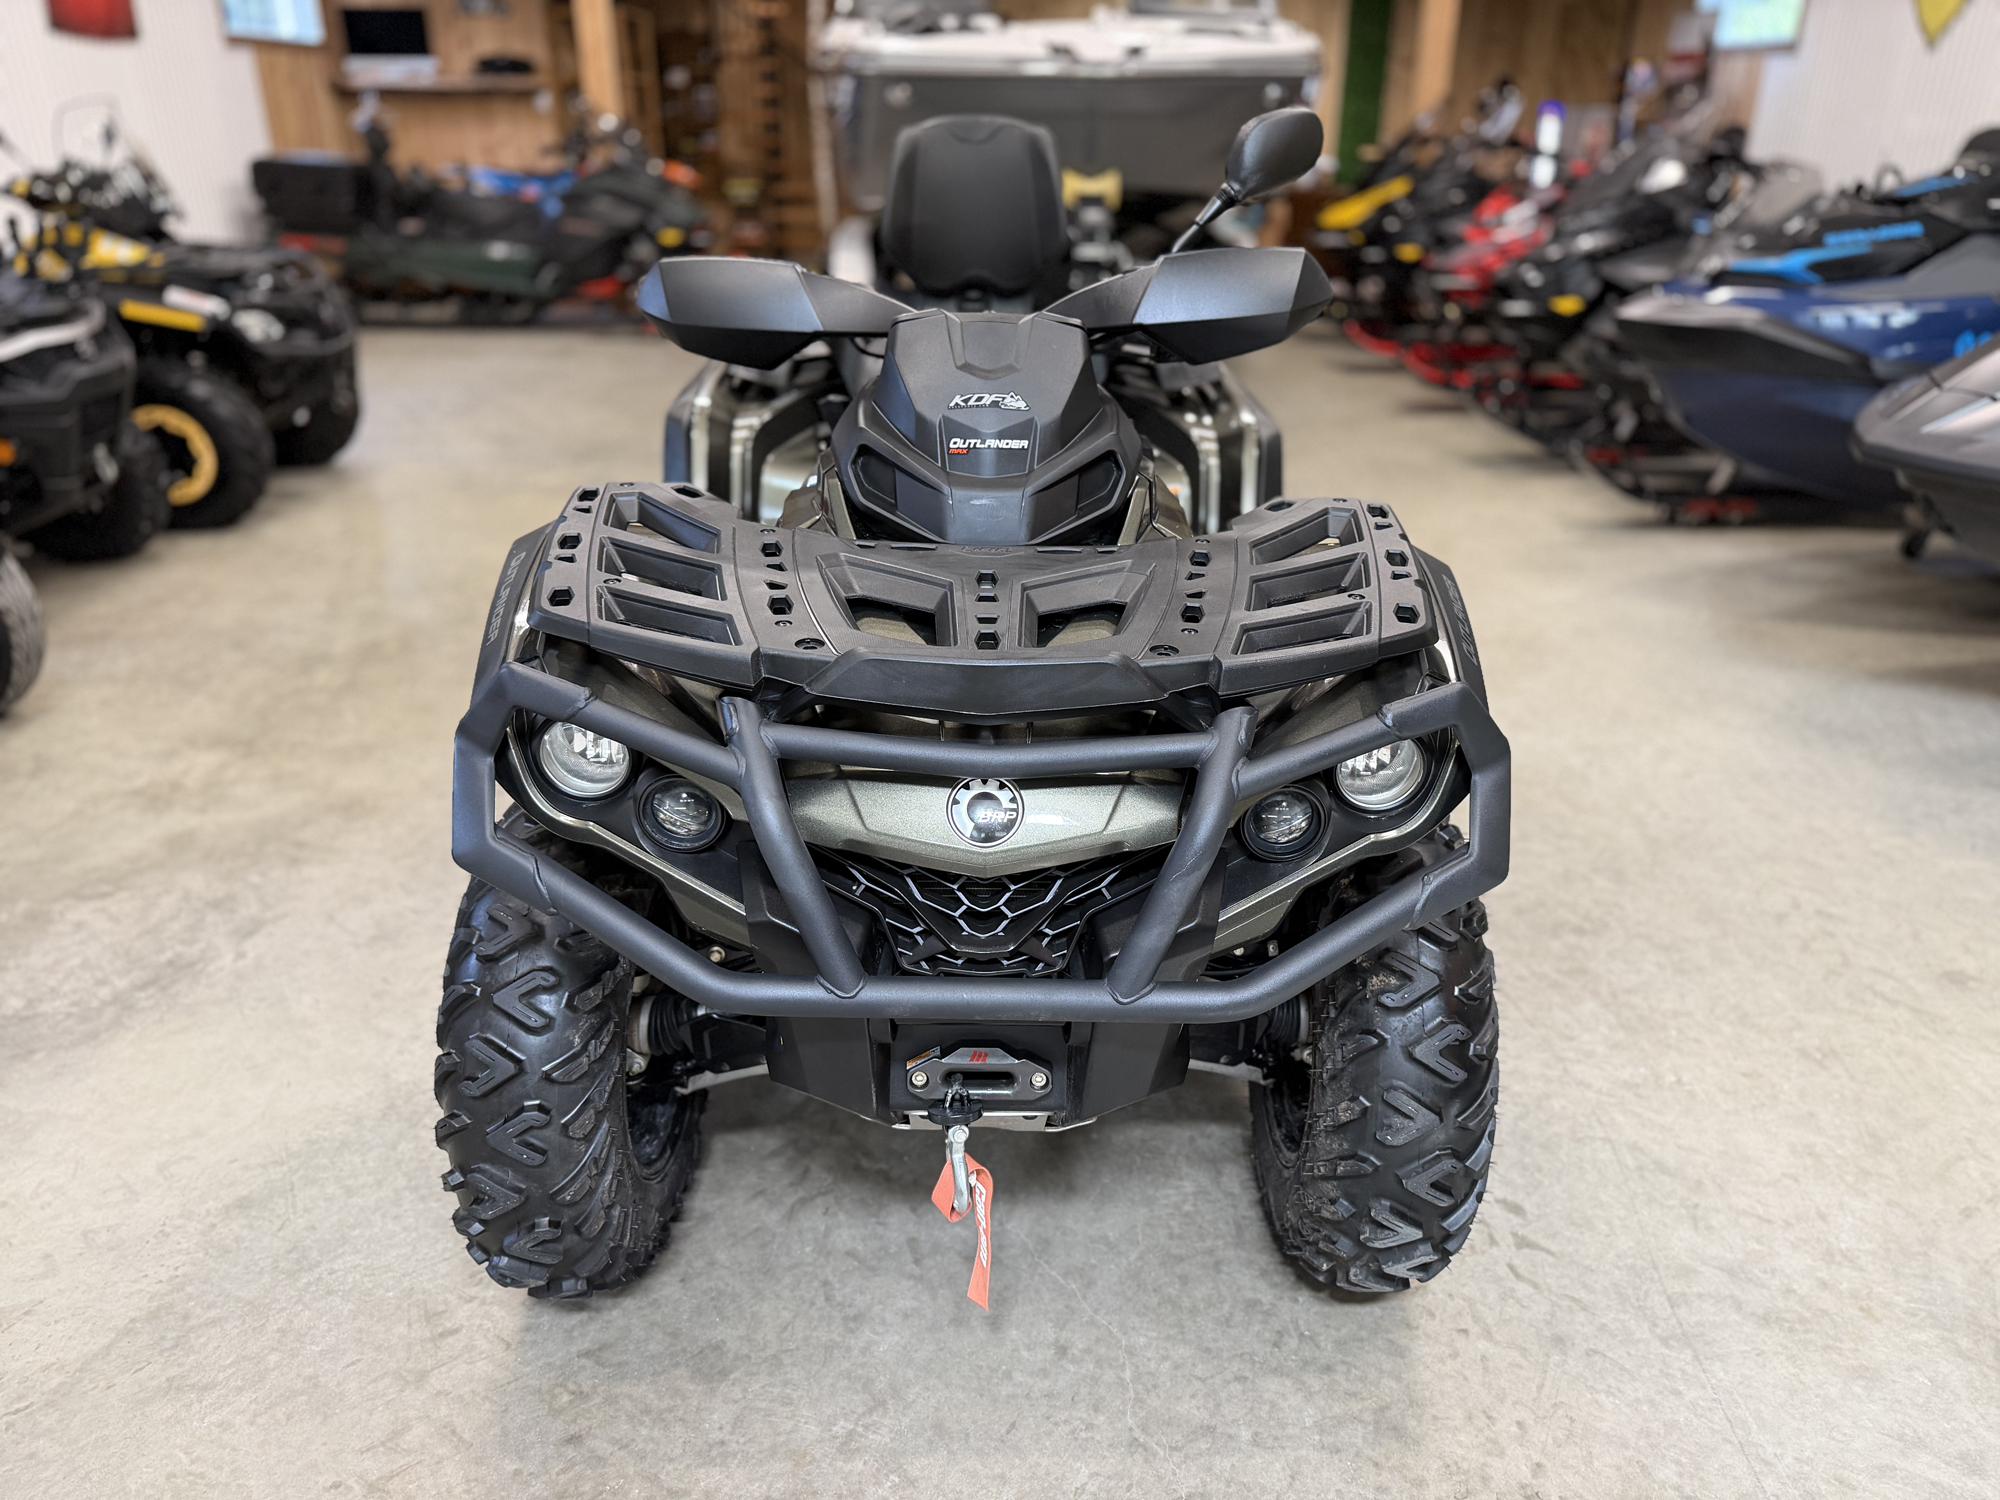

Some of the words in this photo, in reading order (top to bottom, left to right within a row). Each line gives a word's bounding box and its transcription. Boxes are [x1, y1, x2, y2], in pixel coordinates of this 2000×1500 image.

[949, 394, 1009, 407] KDF
[949, 438, 1029, 449] OUTLANDER
[486, 551, 526, 646] OUTLANDER
[978, 811, 1017, 822] BRP
